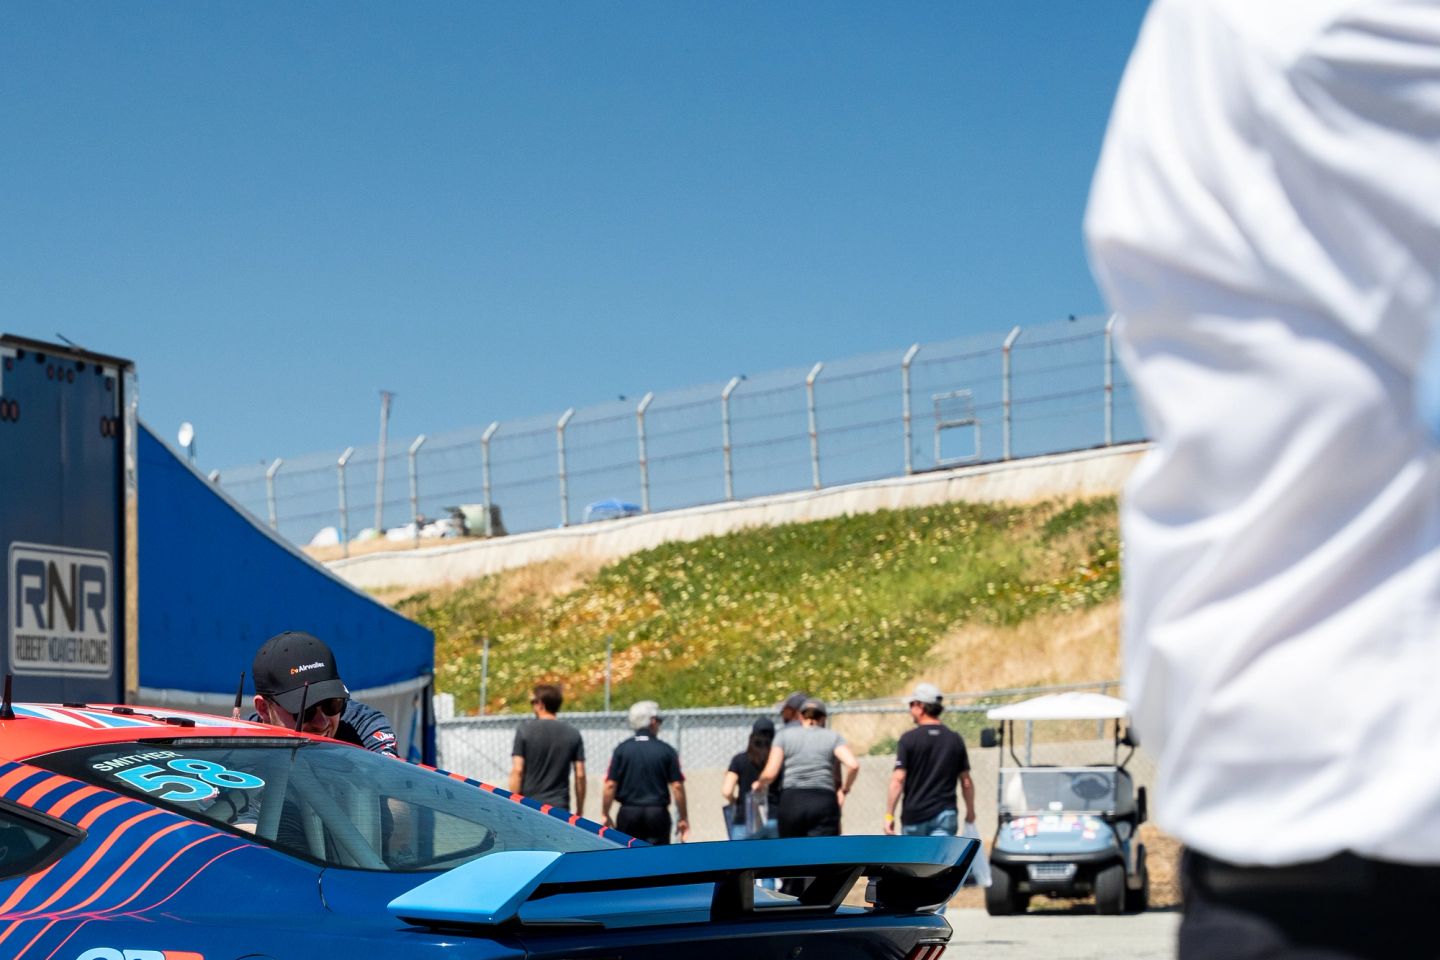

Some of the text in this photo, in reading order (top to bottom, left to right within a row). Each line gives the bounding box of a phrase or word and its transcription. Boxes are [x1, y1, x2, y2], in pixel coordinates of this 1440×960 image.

[16, 558, 107, 634] RNR
[93, 751, 184, 772] SMITHER
[114, 759, 266, 801] 58
